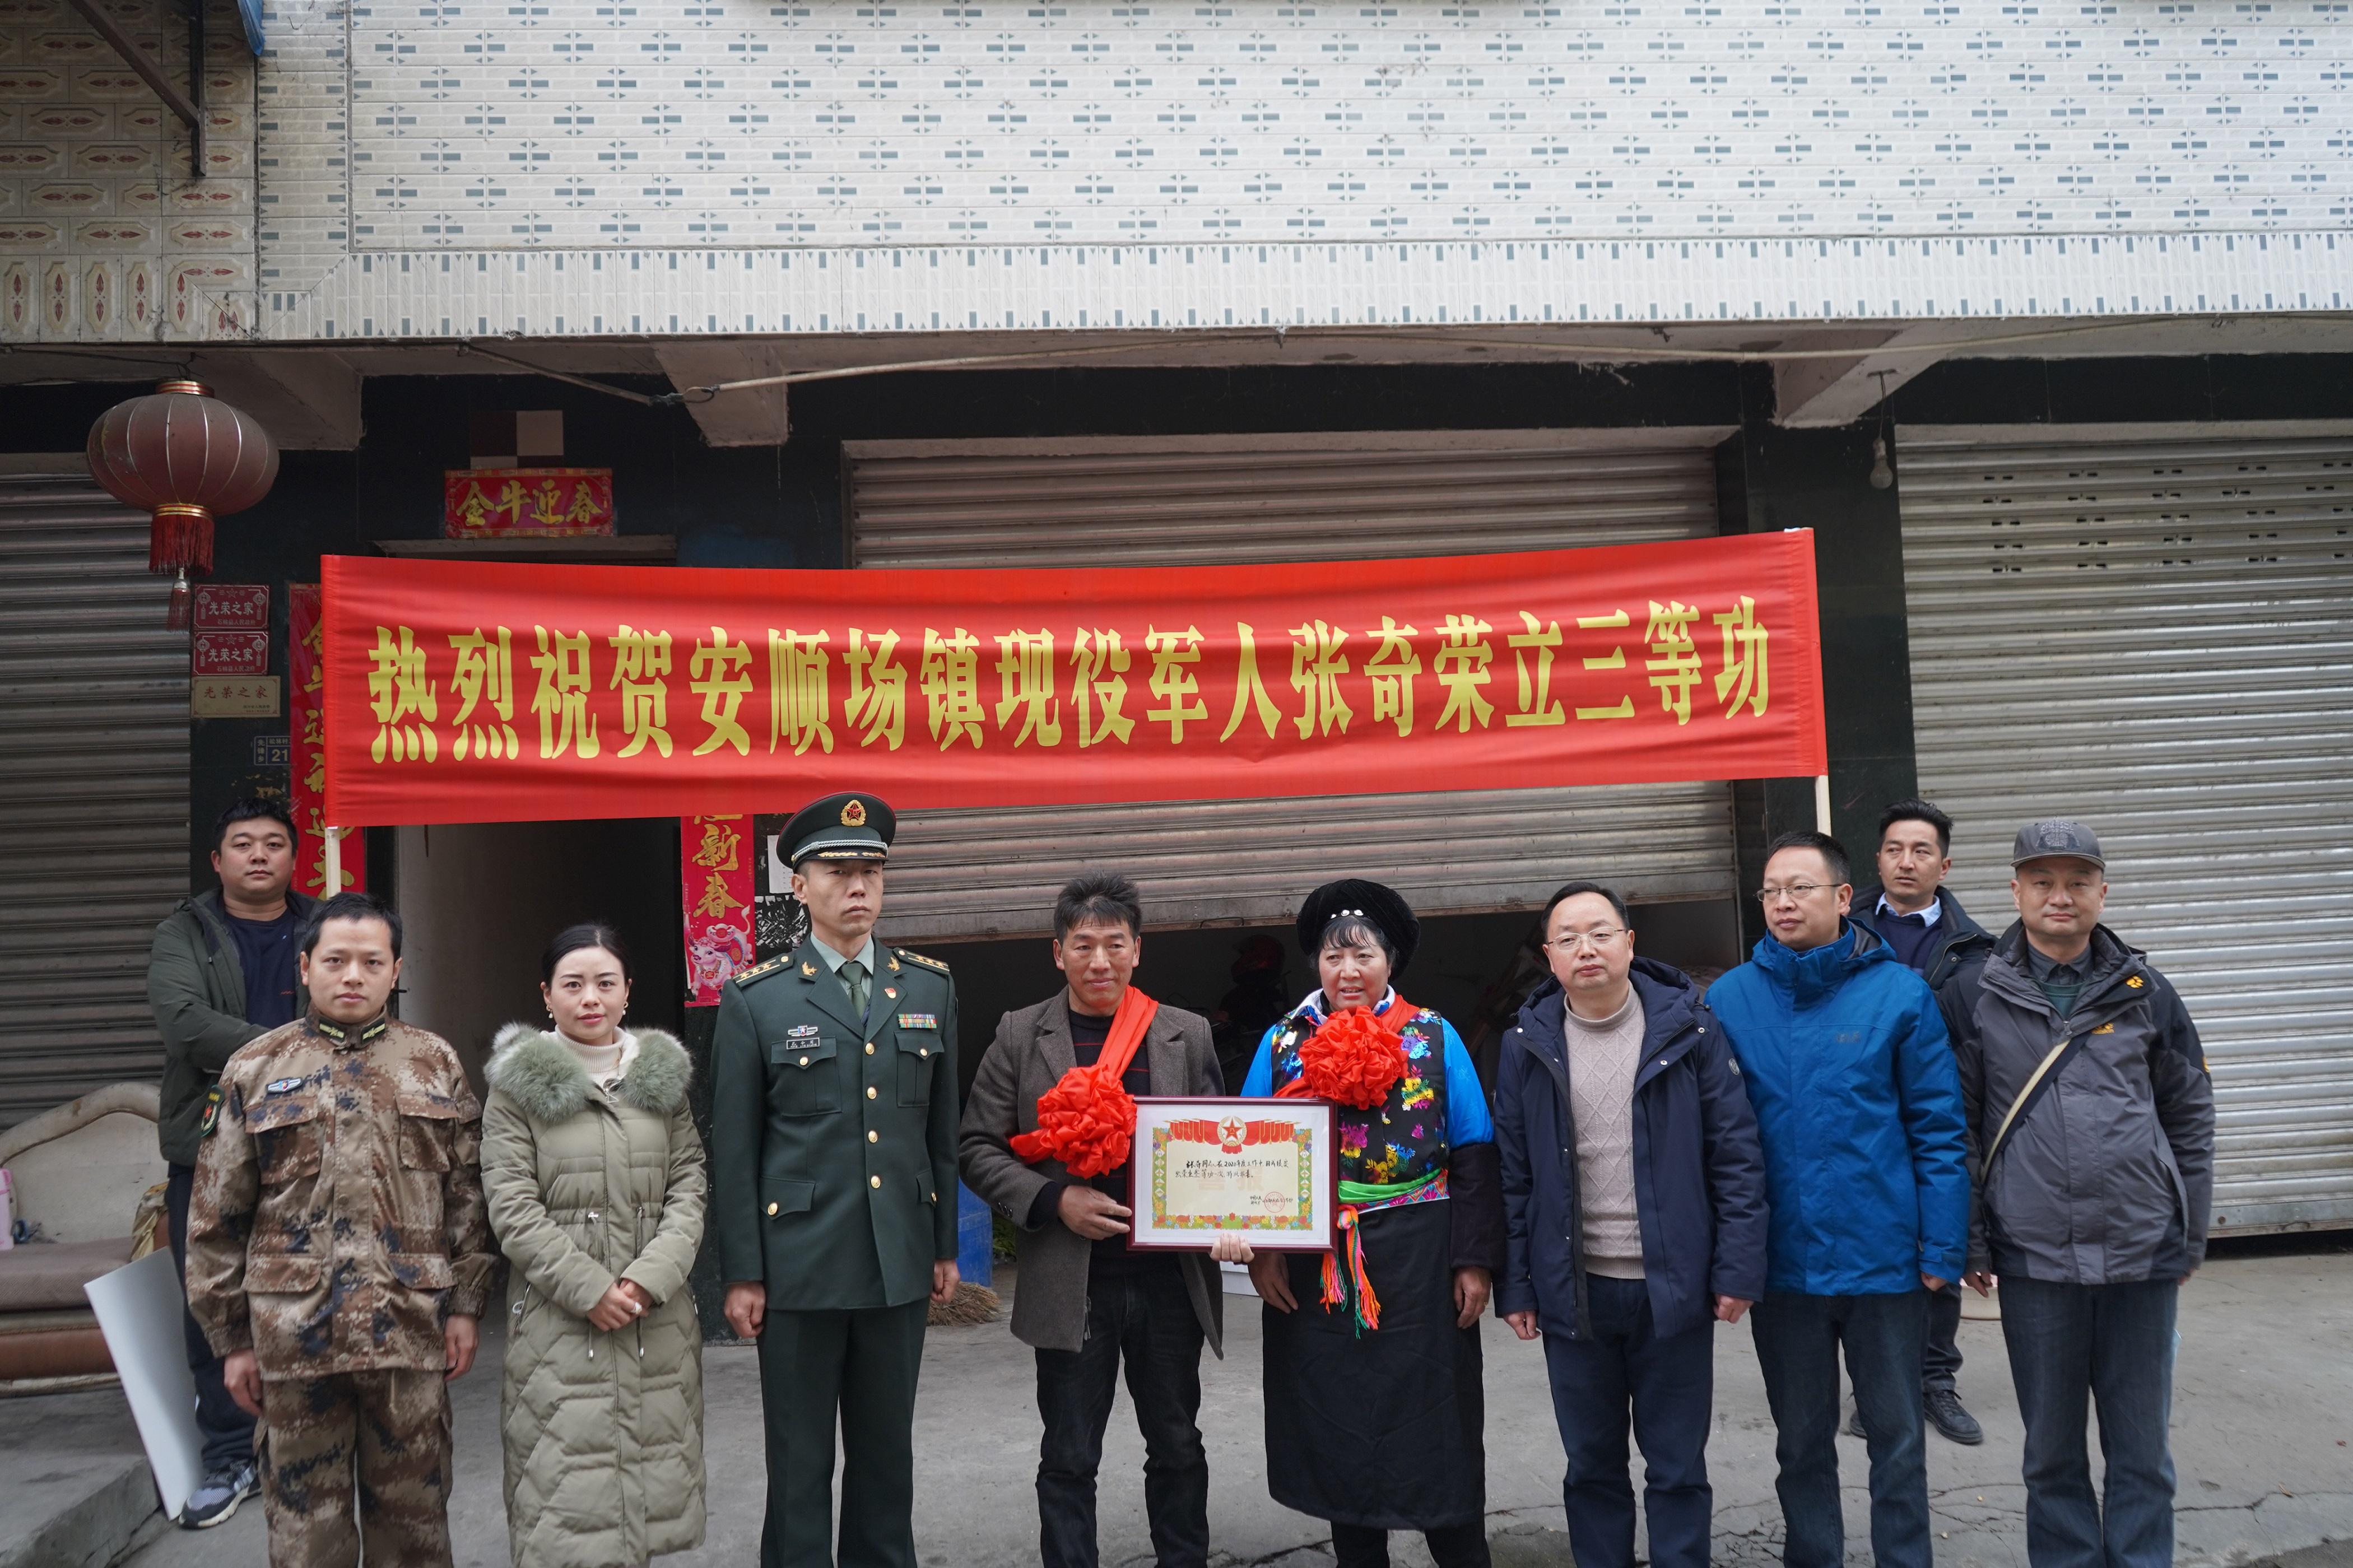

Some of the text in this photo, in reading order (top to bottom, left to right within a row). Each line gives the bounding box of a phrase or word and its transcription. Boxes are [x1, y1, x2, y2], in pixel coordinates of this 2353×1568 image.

[456, 479, 603, 527] 金牛迎春
[208, 601, 254, 616] 光荣之家
[208, 648, 253, 663] 光荣之家
[368, 595, 1769, 764] 热烈祝贺安顺场镇现役军人张奇荣立三等功
[203, 685, 268, 699] 光荣之家
[272, 748, 288, 762] 21
[690, 814, 745, 920] 新春
